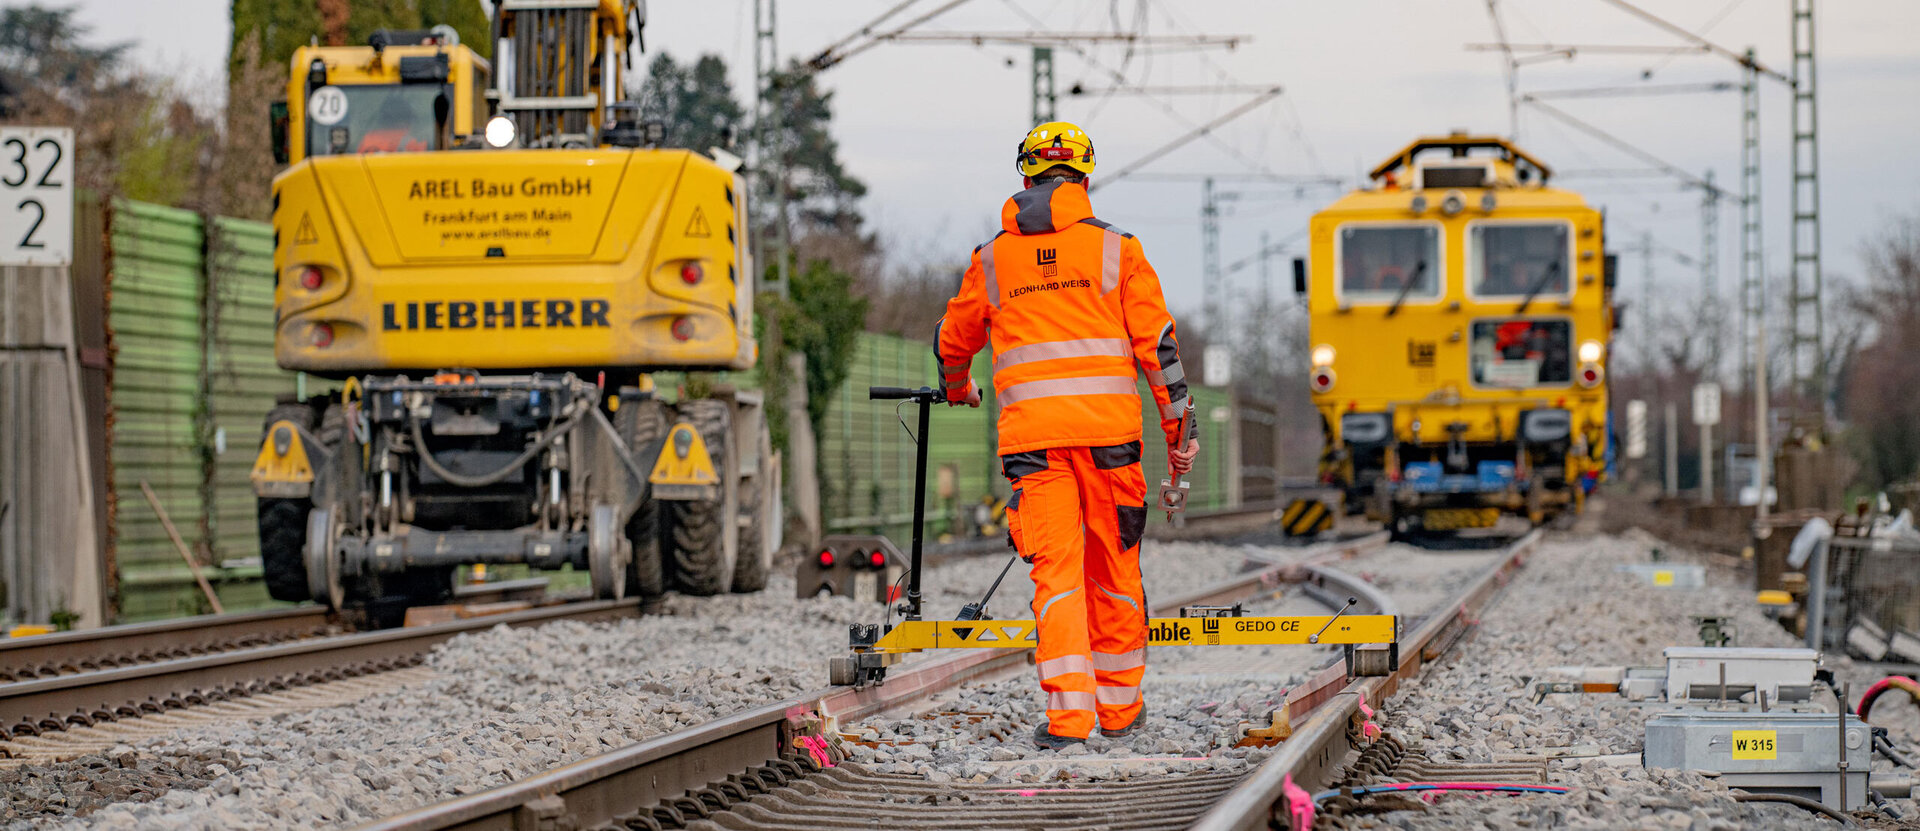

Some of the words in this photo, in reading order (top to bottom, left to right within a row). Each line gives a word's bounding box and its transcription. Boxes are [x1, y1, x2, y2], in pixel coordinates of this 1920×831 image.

[318, 93, 340, 116] 20
[2, 138, 62, 187] 32
[409, 180, 465, 199] AREL
[472, 178, 514, 197] Bau
[521, 177, 592, 197] GmbH
[18, 199, 45, 248] 2
[423, 210, 498, 224] Frankfurt
[504, 212, 528, 222] am
[533, 209, 572, 222] Main
[1009, 282, 1060, 298] LEONHARD
[1061, 279, 1091, 289] WEISS
[382, 299, 611, 331] LIEBHERR
[1235, 620, 1276, 632] GEDO
[1281, 620, 1300, 632] CE
[1736, 740, 1748, 751] W
[1752, 739, 1773, 751] 315
